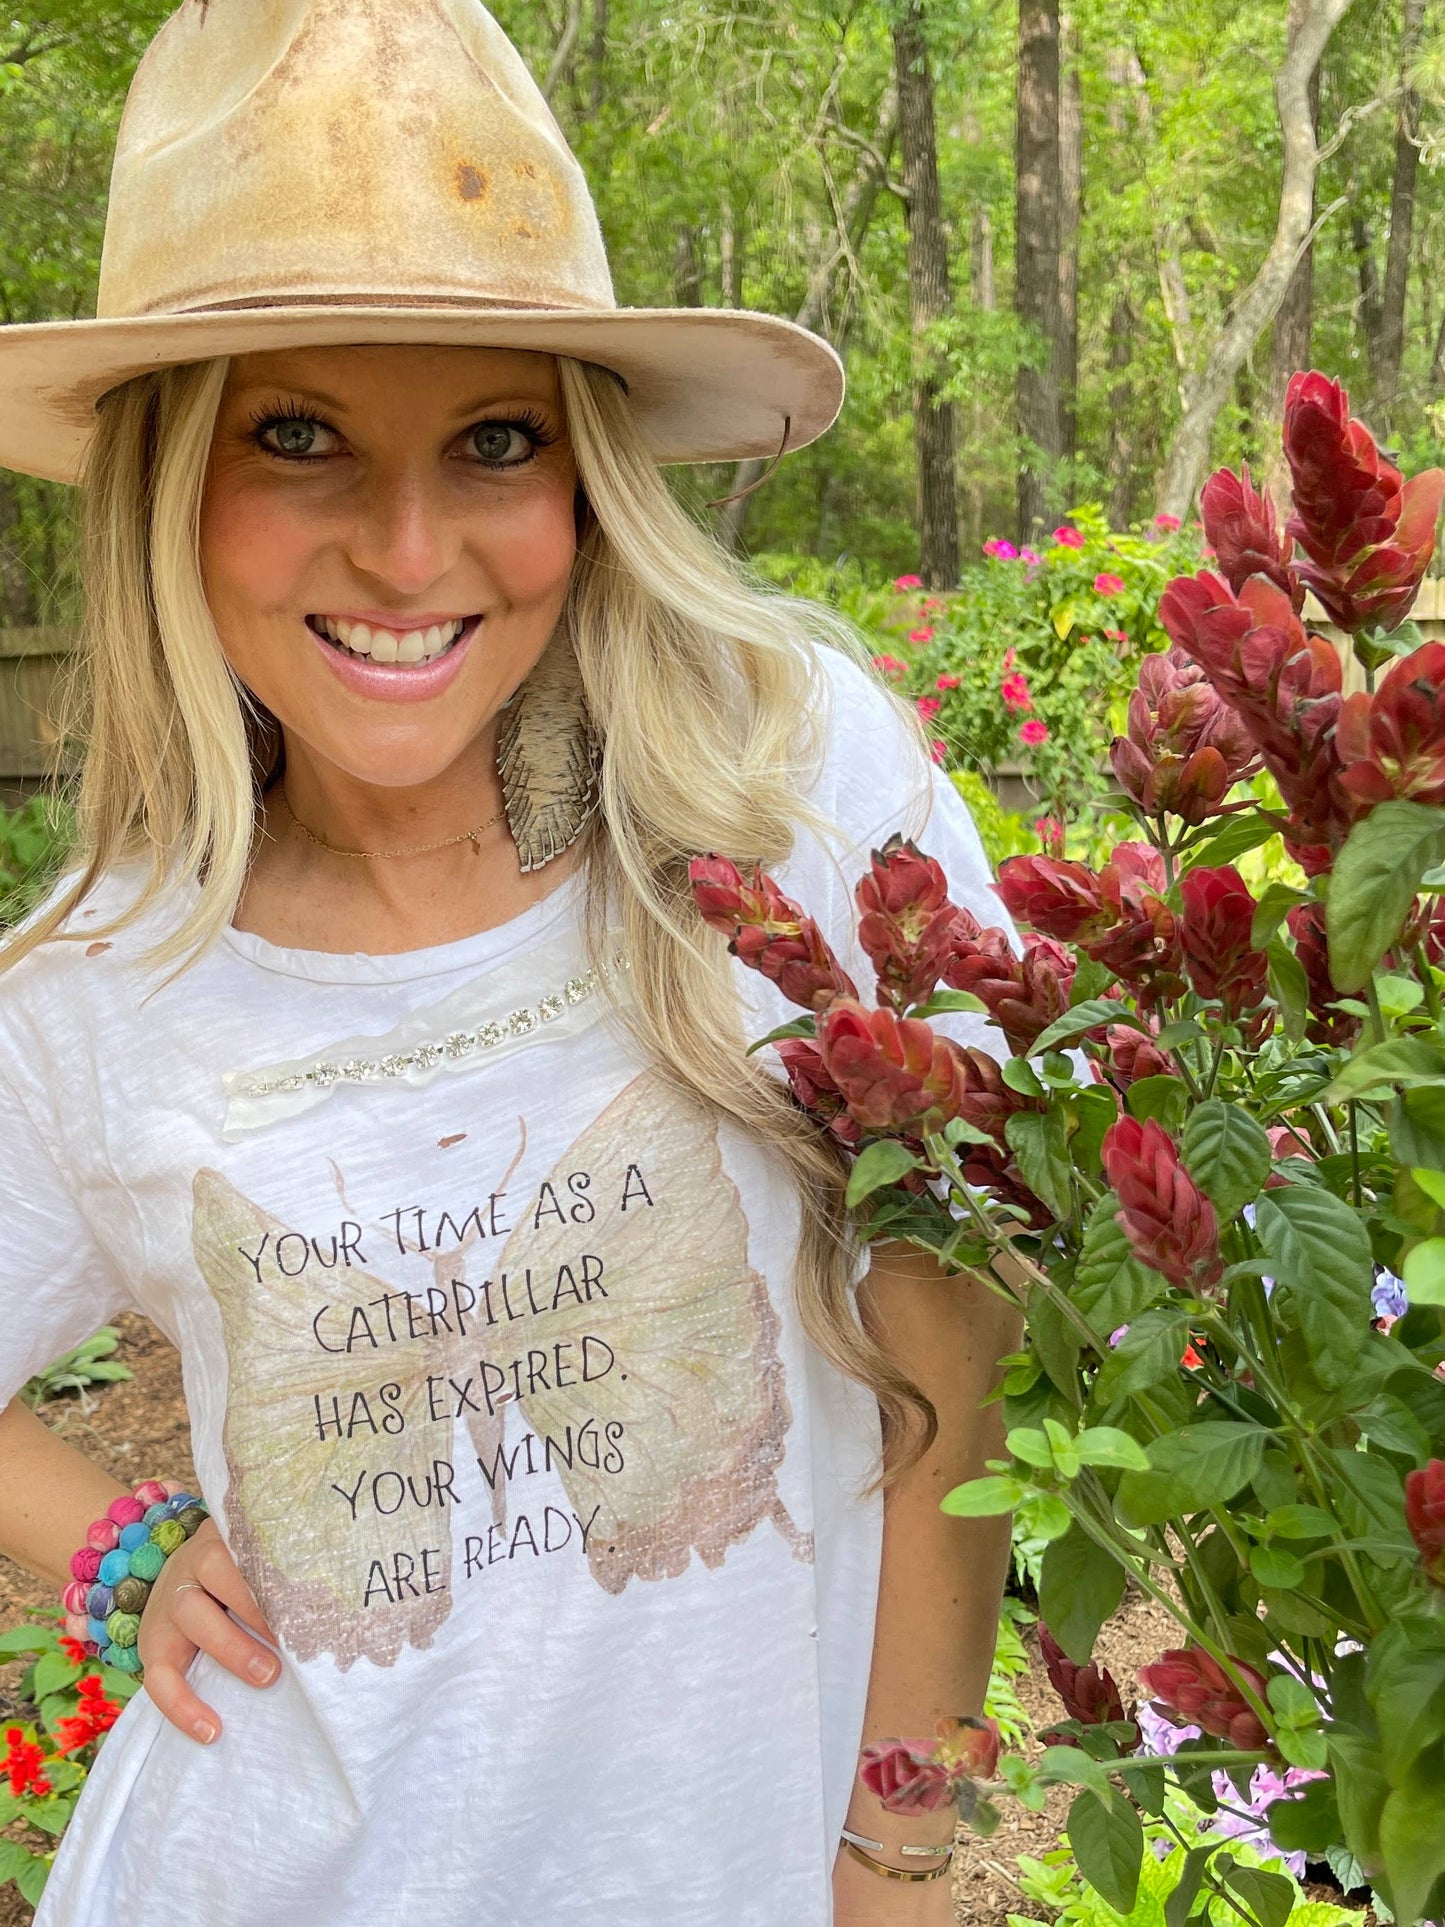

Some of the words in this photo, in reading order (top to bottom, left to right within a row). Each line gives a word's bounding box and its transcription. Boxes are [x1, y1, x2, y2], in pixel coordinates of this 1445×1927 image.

[238, 1221, 367, 1283] YOUR
[380, 1192, 511, 1254] TIME
[533, 1172, 596, 1229] AS
[621, 1164, 654, 1211] A
[313, 1255, 609, 1353] CATERPILLAR
[314, 1383, 405, 1441] HAS
[426, 1336, 628, 1422] EXPIRED.
[332, 1460, 462, 1520] YOUR
[477, 1419, 625, 1490] WINGS
[363, 1549, 446, 1607] ARE
[463, 1504, 616, 1578] READY.
